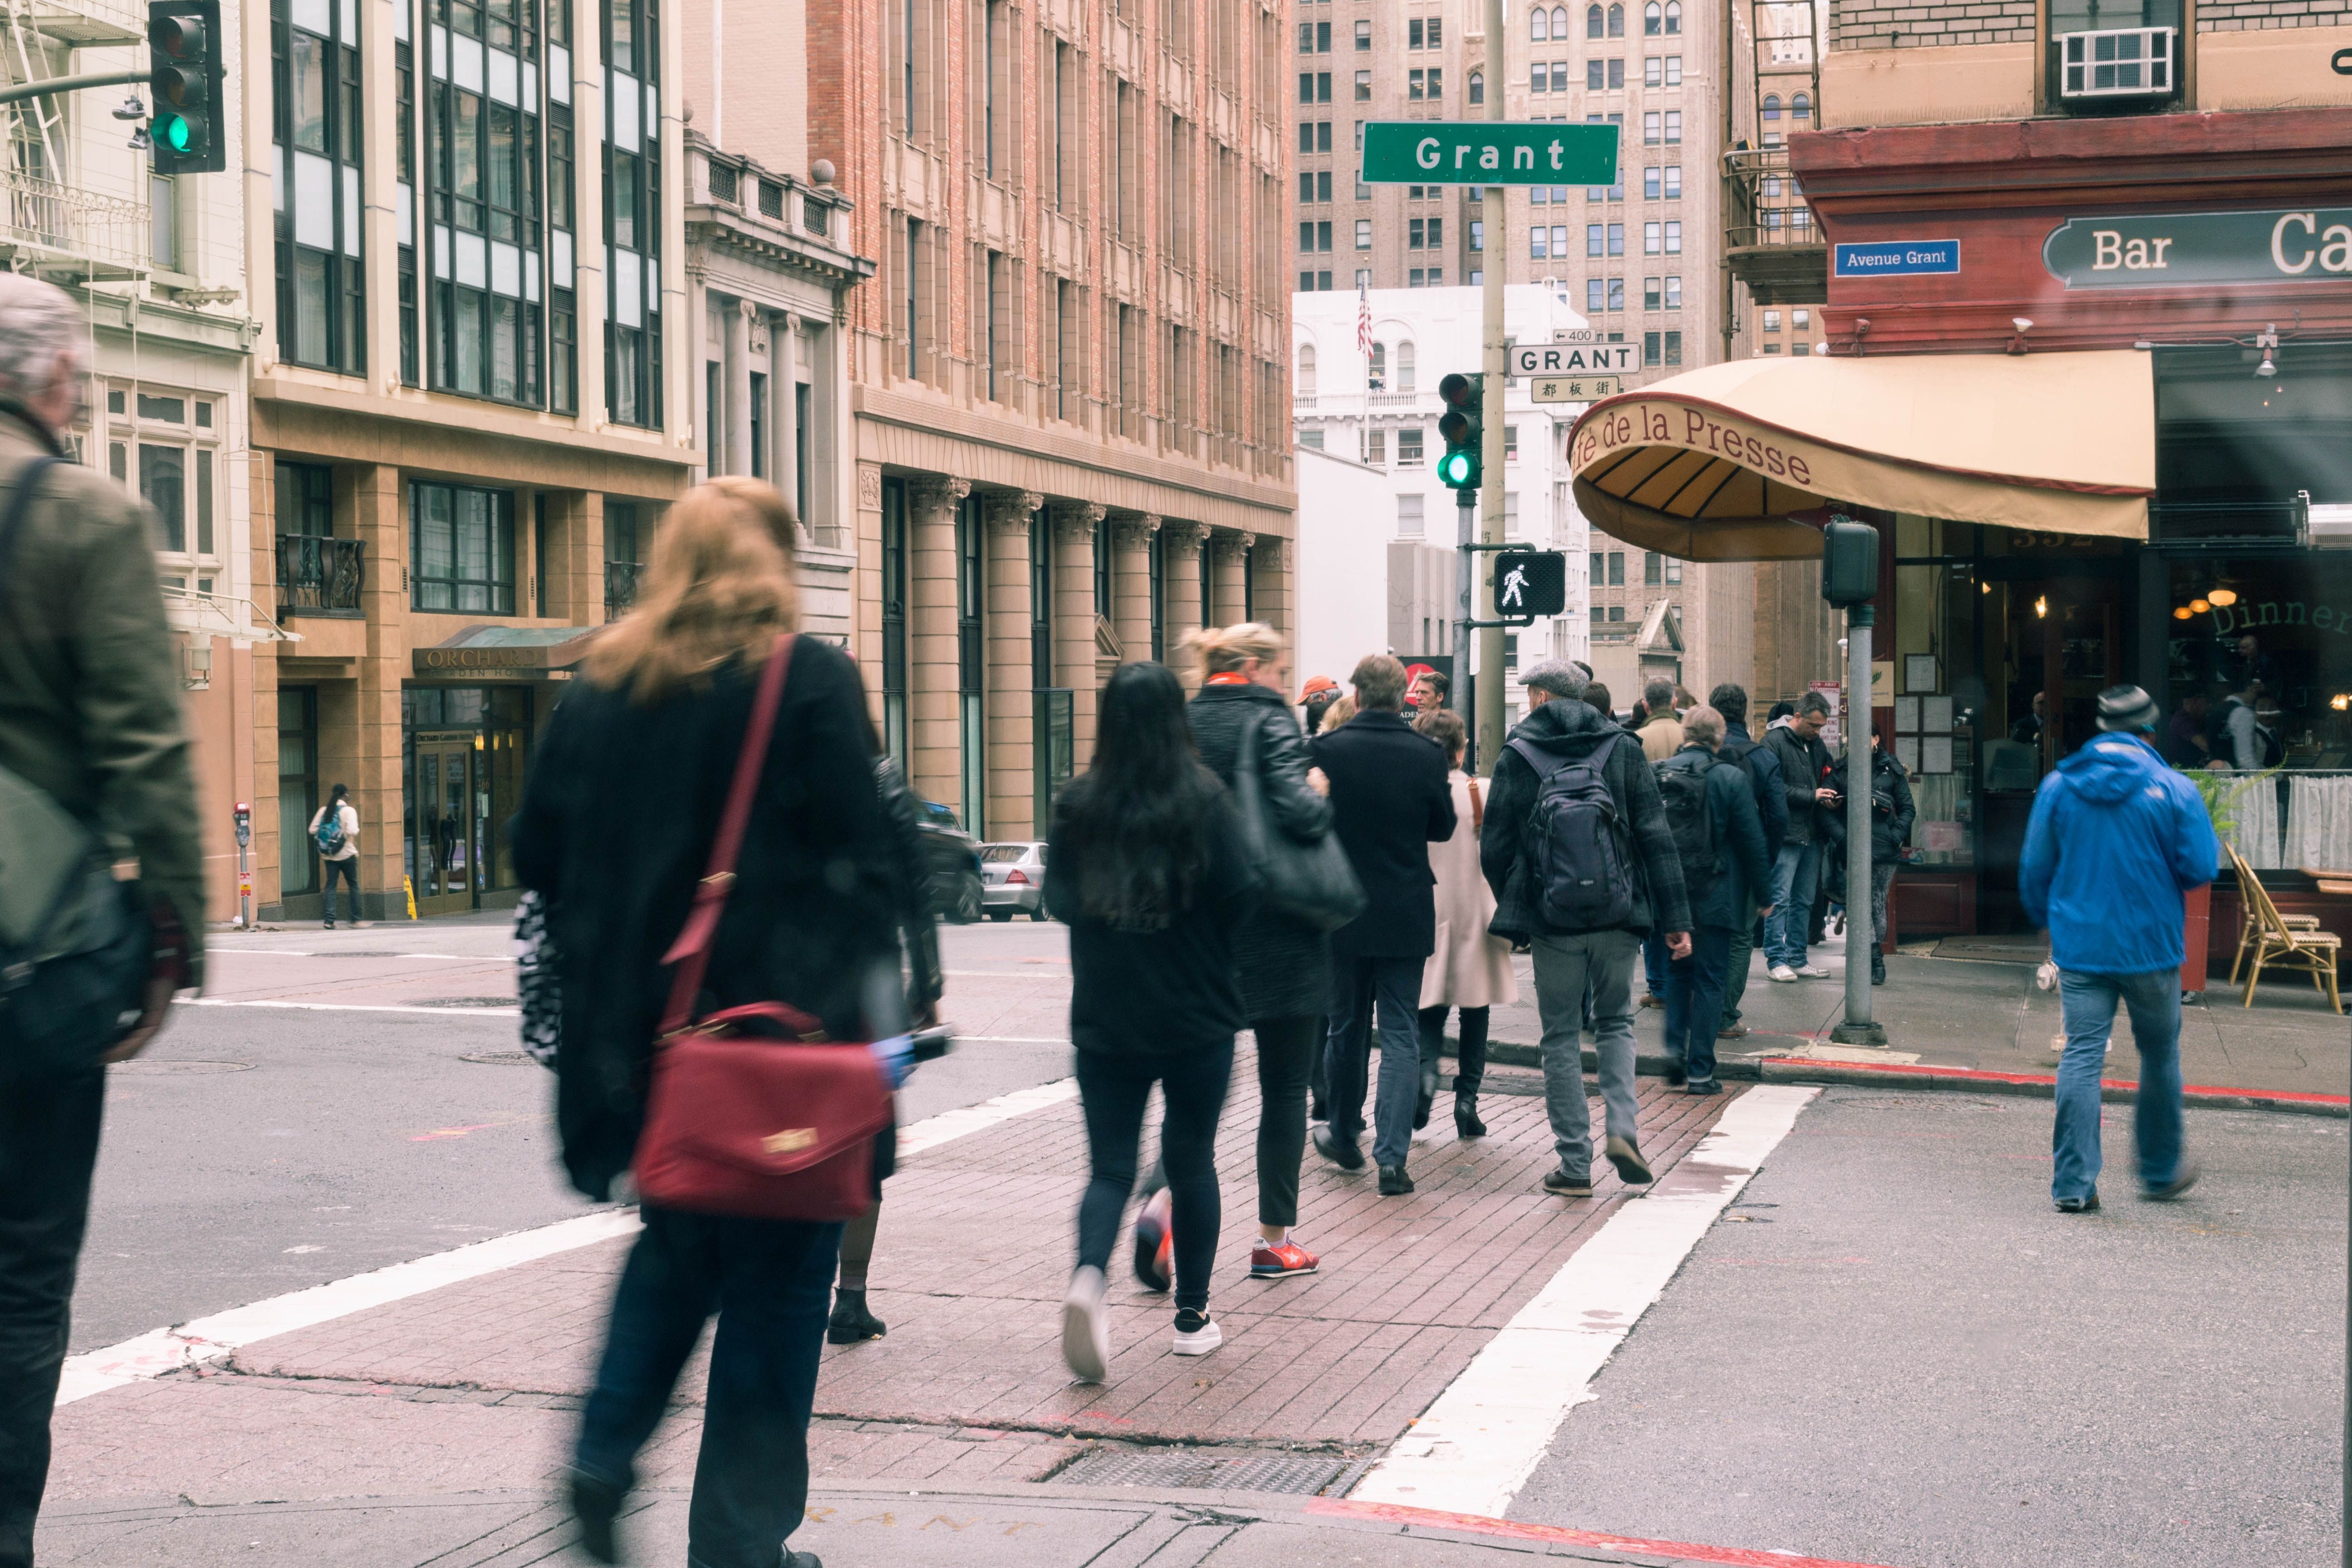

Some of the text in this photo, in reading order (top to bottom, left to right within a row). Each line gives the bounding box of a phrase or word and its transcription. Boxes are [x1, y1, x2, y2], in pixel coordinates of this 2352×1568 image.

[1416, 137, 1564, 170] Grant
[1847, 251, 1946, 267] Avenue Grant
[2092, 230, 2172, 270] Bar
[1569, 331, 1591, 341] 400
[1521, 349, 1630, 371] GRANT
[1541, 382, 1610, 398] 都板街
[1603, 411, 1630, 448] de
[1641, 405, 1671, 441] la
[1683, 408, 1811, 485] Presse
[2208, 598, 2352, 636] Dinner
[427, 650, 537, 667] ORCHARD
[804, 1506, 1044, 1535] RANT
